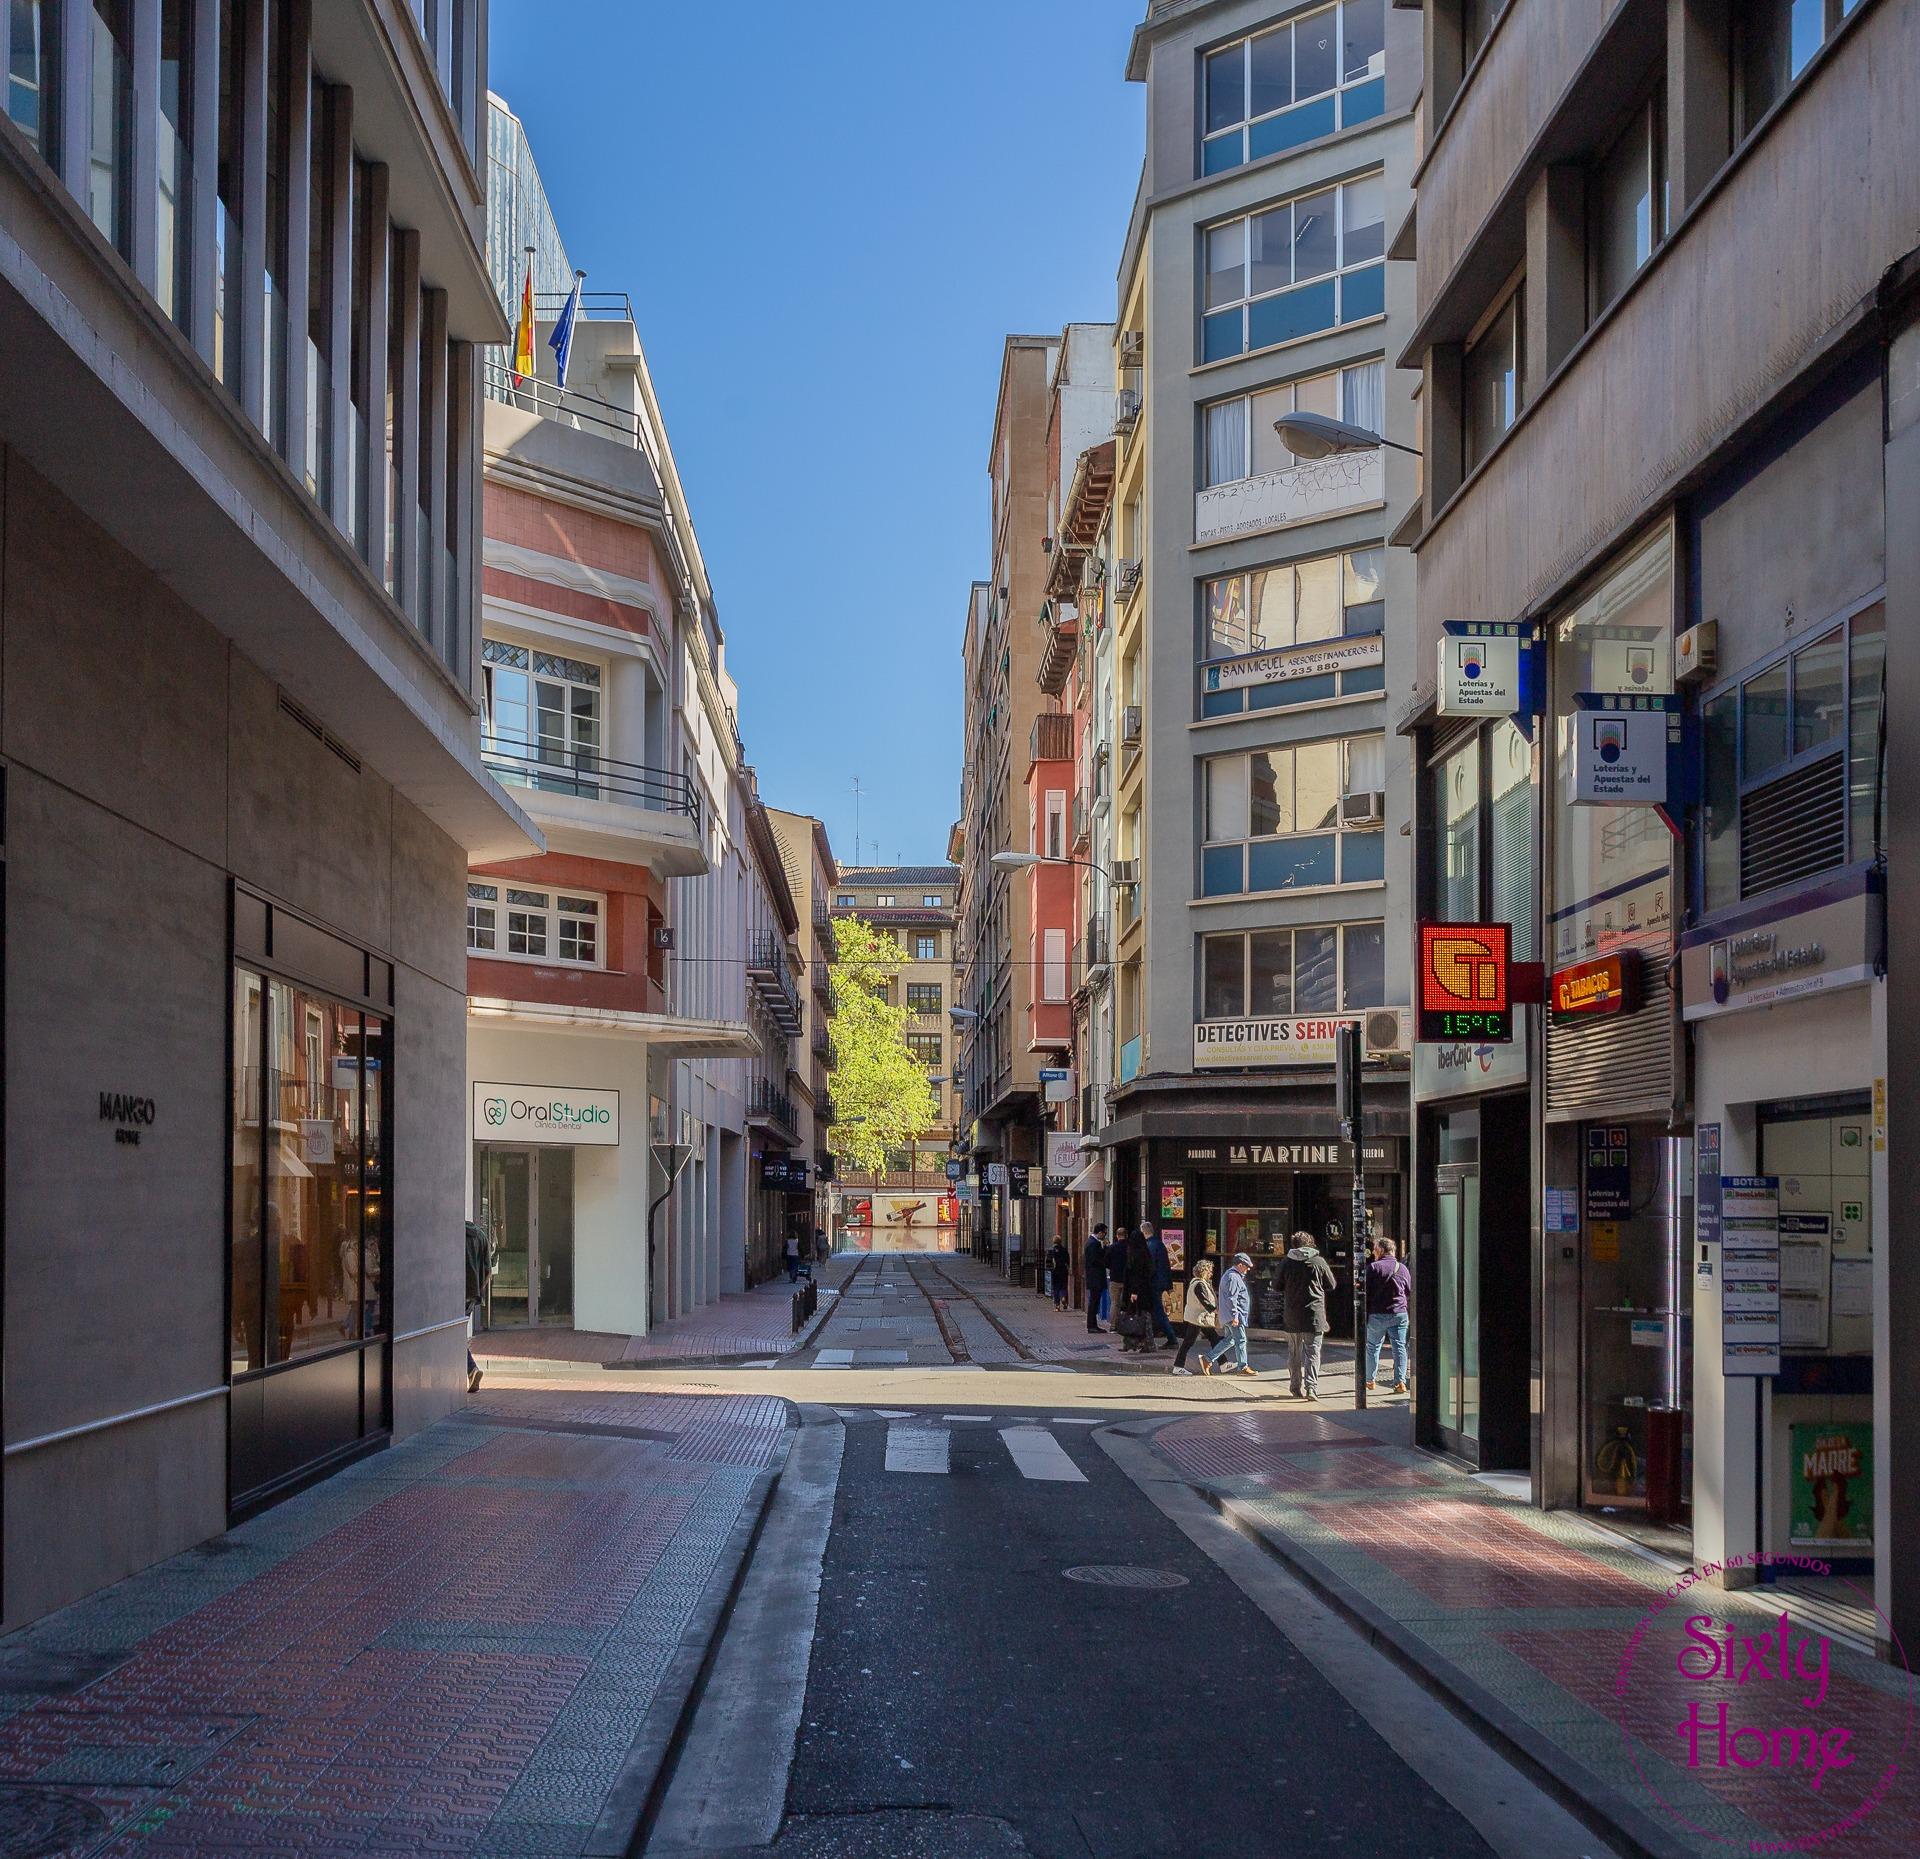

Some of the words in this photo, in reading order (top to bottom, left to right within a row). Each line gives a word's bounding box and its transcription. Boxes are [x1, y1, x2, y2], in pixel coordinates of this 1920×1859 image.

[1222, 663, 1246, 678] SAN
[1247, 656, 1284, 673] MIGUEL
[1288, 653, 1322, 667] ASESORES
[1264, 670, 1287, 680] 976
[1291, 665, 1312, 676] 235
[1316, 661, 1340, 672] 880
[1458, 689, 1493, 697] Apuestas
[1593, 764, 1629, 773] Loterías
[1631, 766, 1637, 774] y
[1594, 775, 1635, 785] Apuestas
[1637, 775, 1651, 783] del
[1593, 784, 1624, 793] Estado
[1570, 971, 1609, 1000] TABACOS
[1197, 1022, 1290, 1043] DETECTIVES
[100, 1092, 155, 1125] MANGO
[510, 1100, 610, 1124] OralStudio
[558, 1121, 582, 1130] Dental
[1230, 1146, 1248, 1161] LA
[1250, 1145, 1339, 1163] TARTINE
[1732, 1178, 1767, 1187] BOTES
[1588, 1200, 1618, 1209] Apuestas
[1619, 1199, 1630, 1207] del
[1588, 1209, 1611, 1218] Estado
[1804, 1449, 1858, 1478] MADRE
